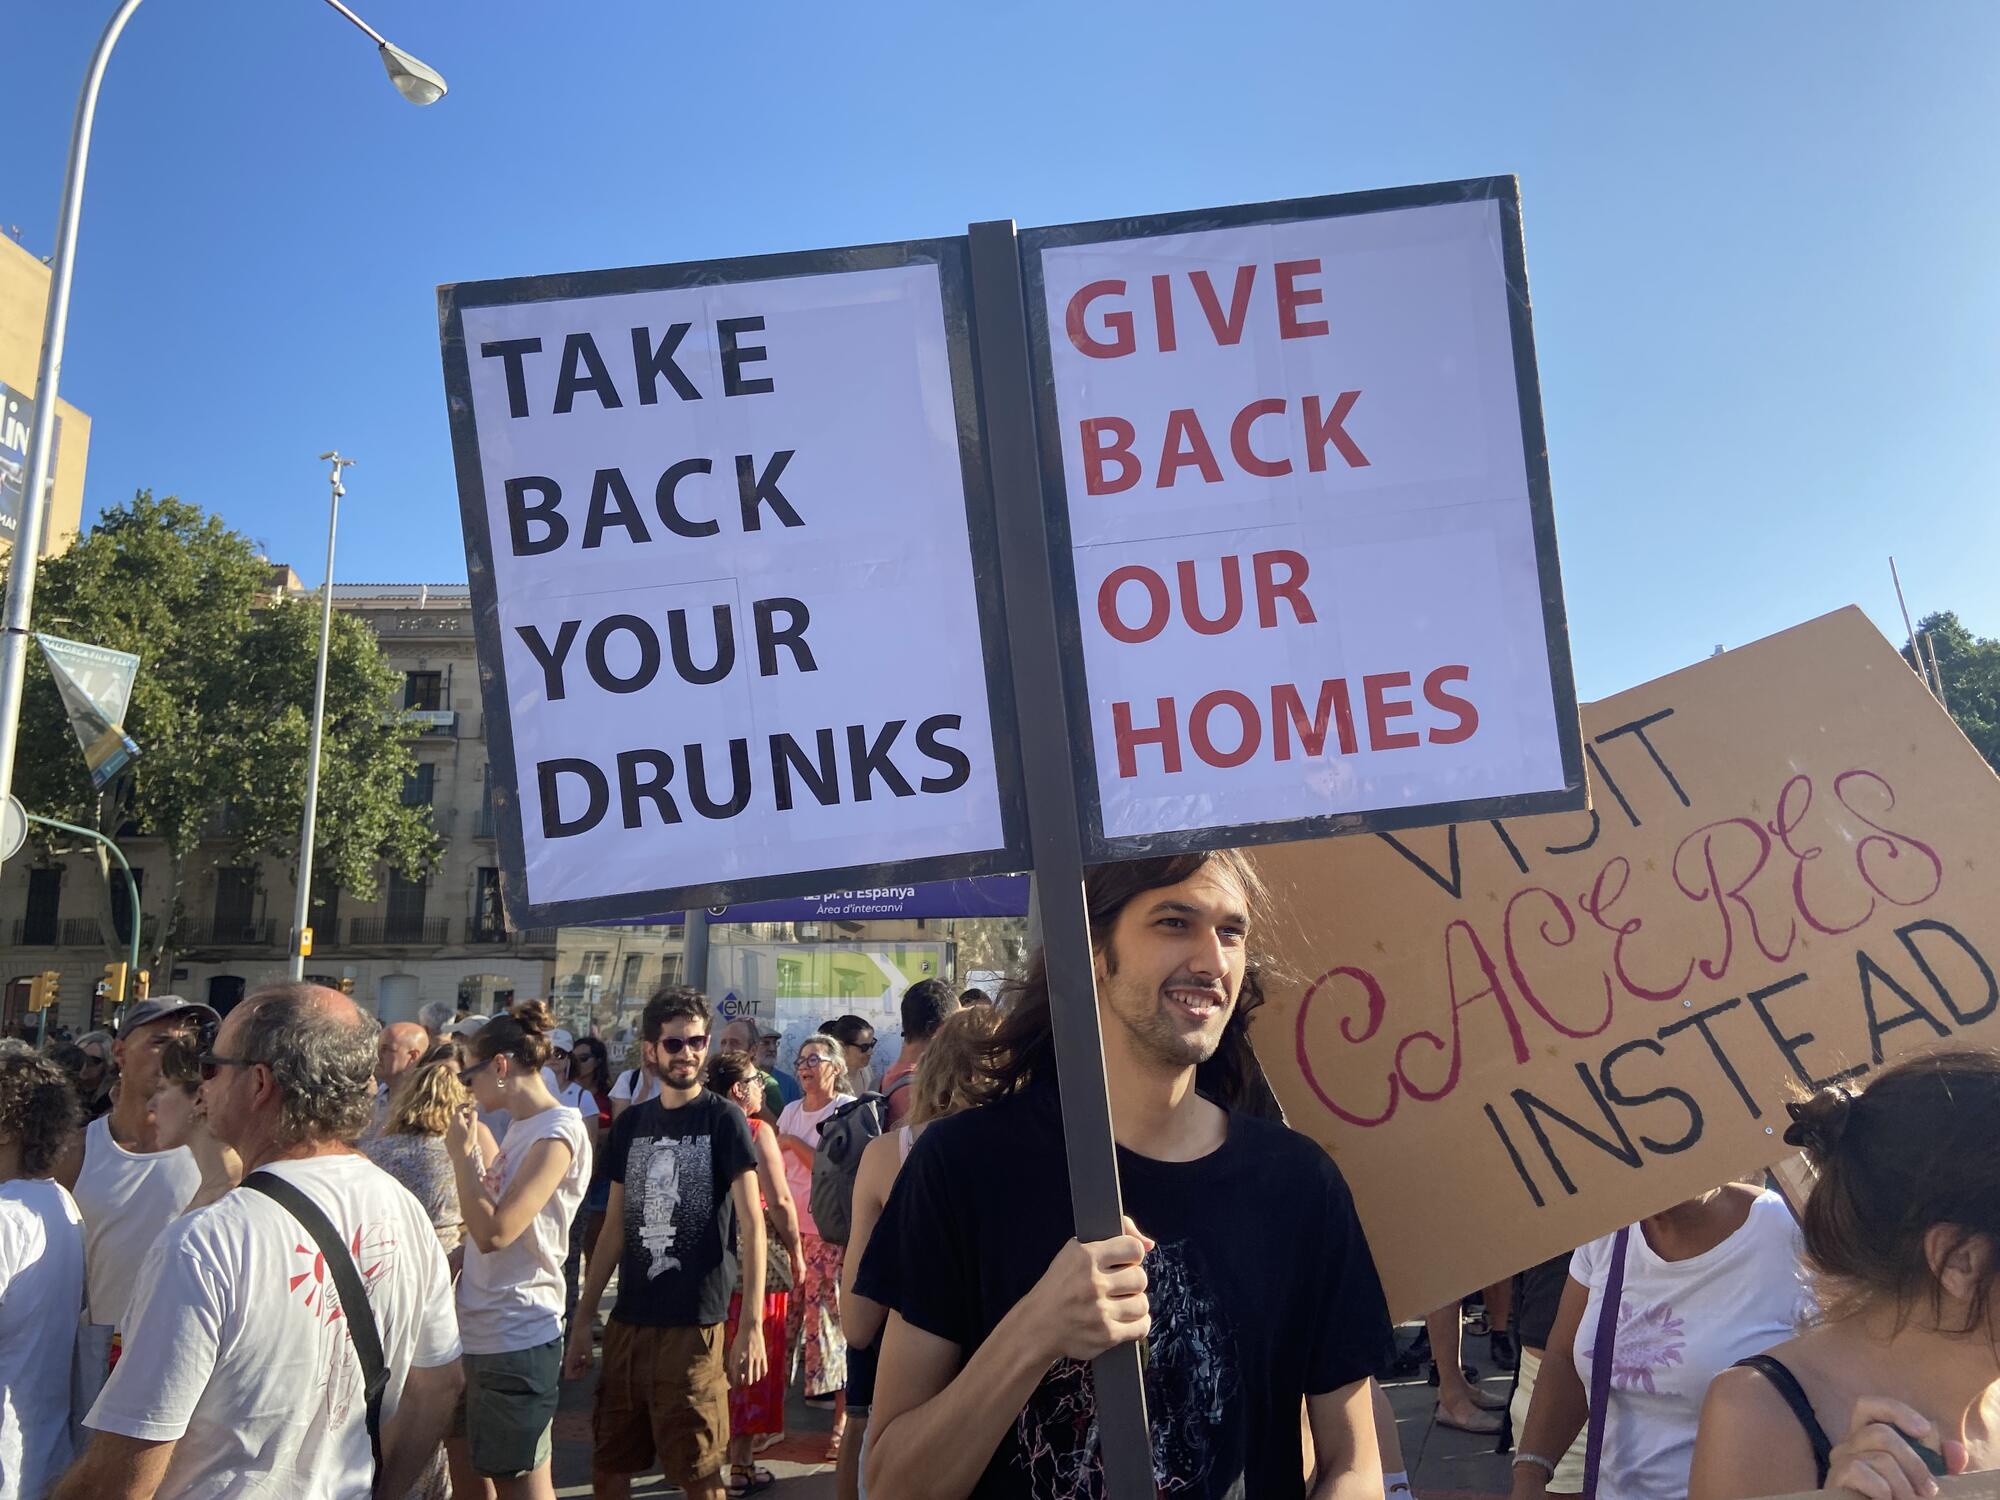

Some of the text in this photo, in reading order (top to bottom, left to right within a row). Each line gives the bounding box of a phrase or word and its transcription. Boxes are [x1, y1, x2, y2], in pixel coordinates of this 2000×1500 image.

[1065, 258, 1329, 359] GIVE
[481, 315, 774, 418] TAKE
[1079, 390, 1371, 496] BACK
[504, 450, 805, 557] BACK
[514, 596, 818, 701] YOUR
[1097, 549, 1318, 644] OUR
[1112, 664, 1480, 778] HOMES
[536, 713, 970, 839] DRUNKS
[816, 902, 903, 915] Àrea d'intercanvi
[843, 887, 915, 901] dEspanya
[1295, 769, 1943, 1128] CACERES
[1483, 918, 2000, 1207] INSTEAD
